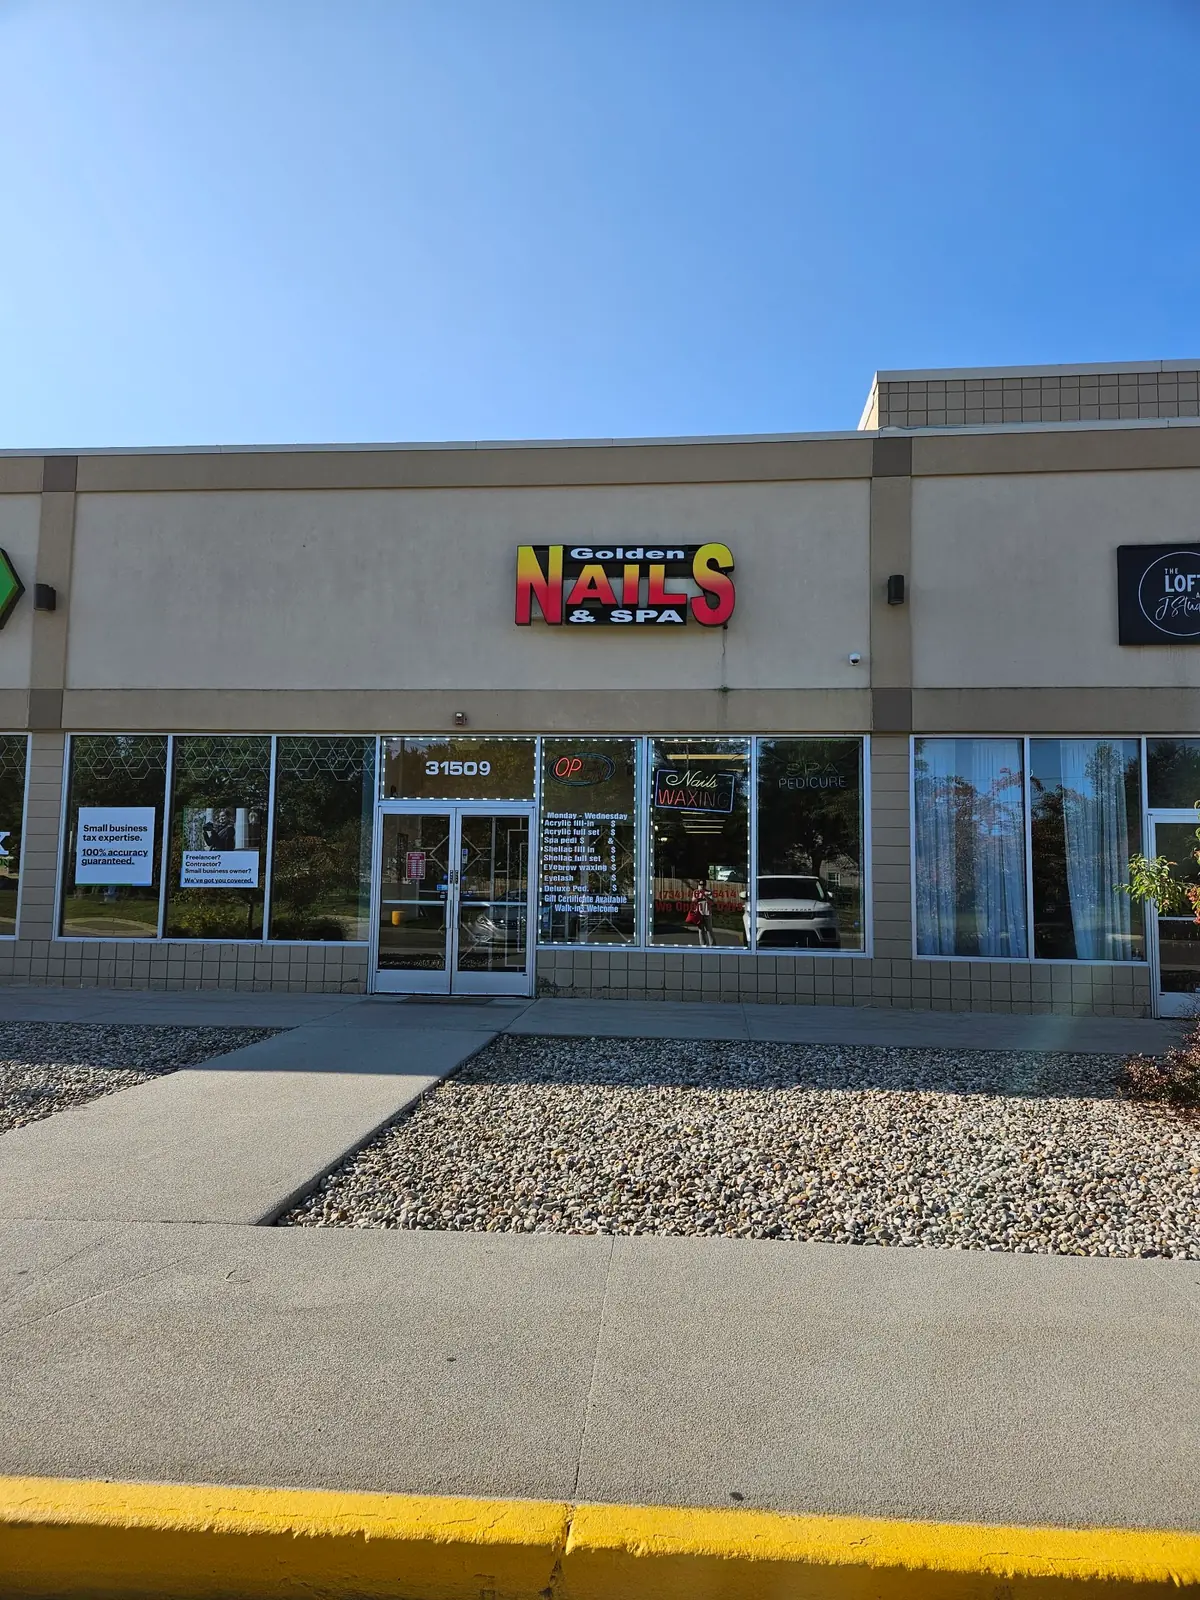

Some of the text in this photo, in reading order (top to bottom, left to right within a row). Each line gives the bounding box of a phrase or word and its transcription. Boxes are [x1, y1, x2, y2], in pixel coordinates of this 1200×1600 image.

[570, 547, 685, 560] Golden
[515, 542, 736, 626] NAILS
[569, 609, 684, 623] & SPA
[425, 760, 491, 776] 31509
[665, 770, 719, 788] Nails
[778, 776, 847, 790] PEDICURE
[584, 812, 628, 820] Wednesday
[83, 824, 148, 832] Small business
[98, 834, 143, 843] expertise.
[82, 848, 149, 858] 100% accuracy
[81, 857, 136, 866] guaranteed.
[544, 894, 627, 904] Gift Certificate Available
[555, 904, 619, 912] Walk-ins Welcome
[656, 902, 672, 912] We
